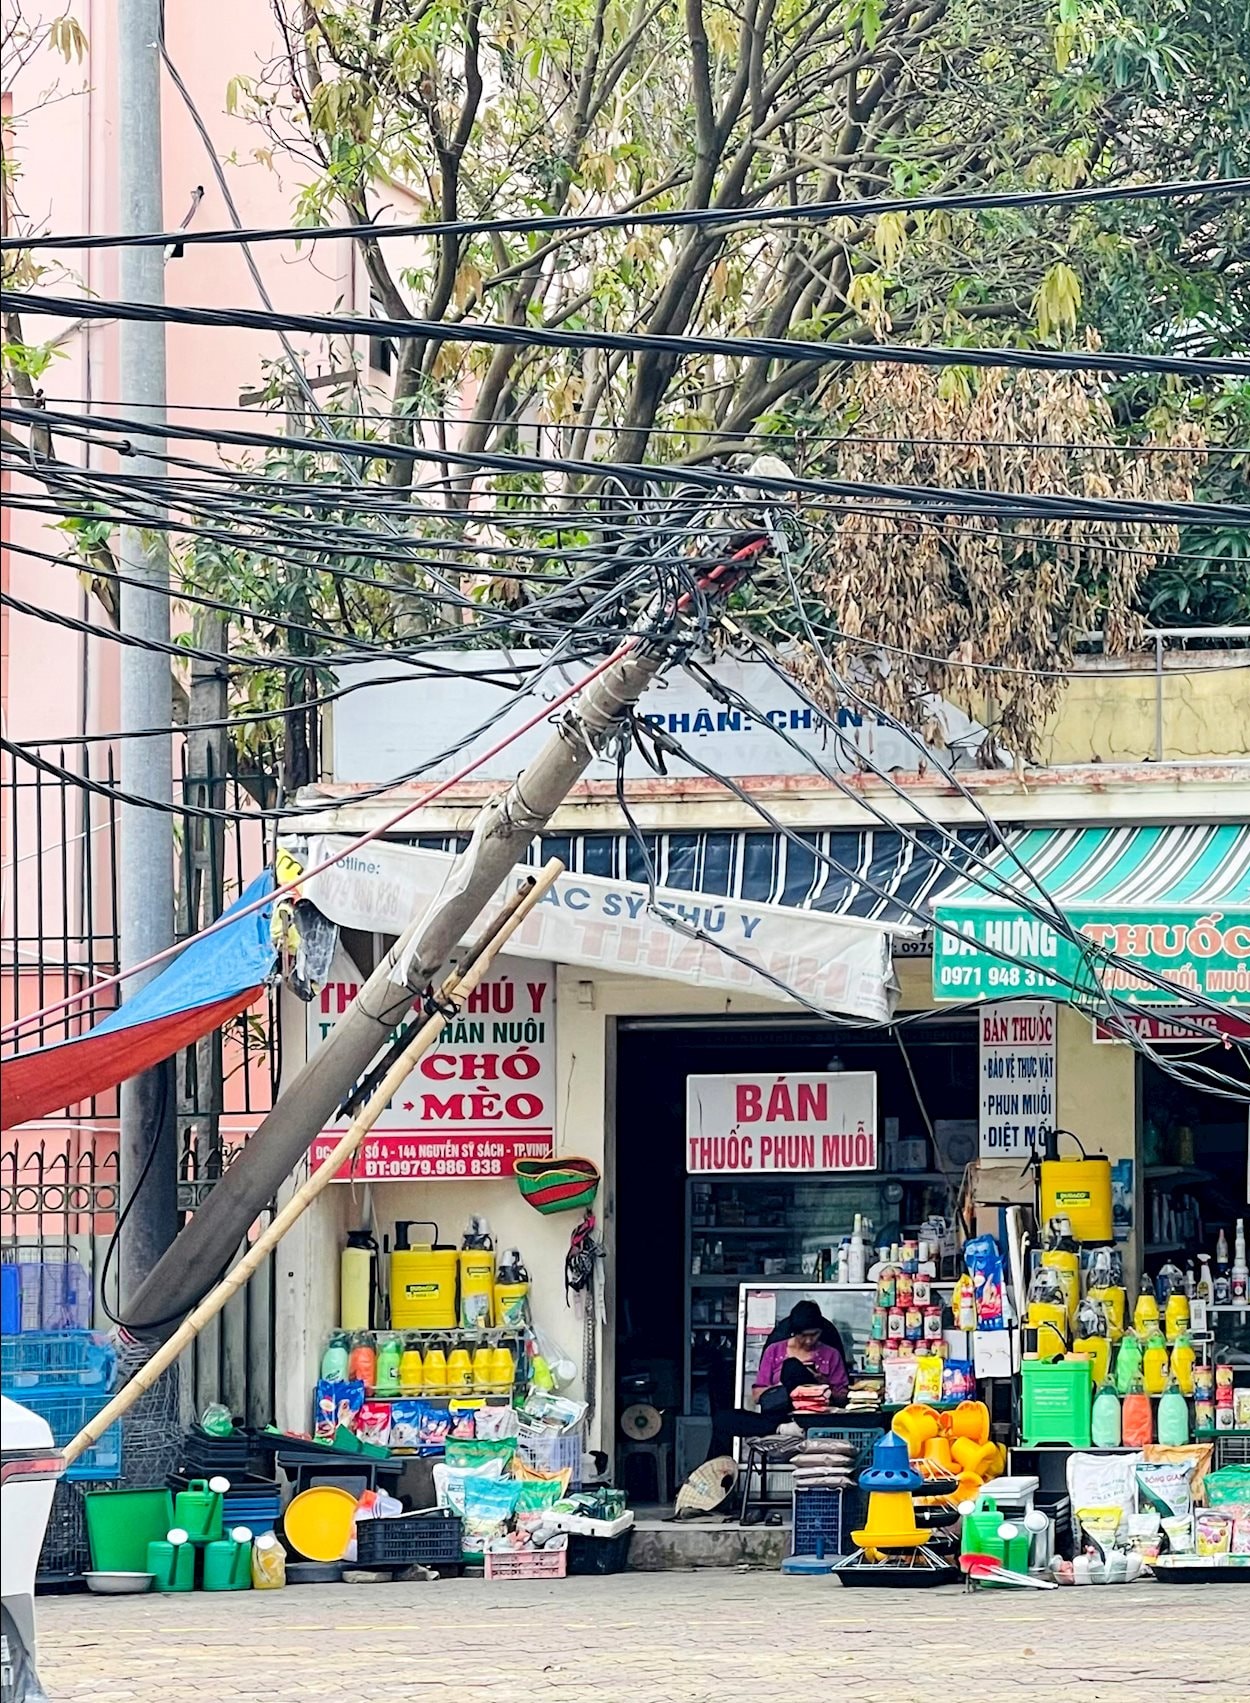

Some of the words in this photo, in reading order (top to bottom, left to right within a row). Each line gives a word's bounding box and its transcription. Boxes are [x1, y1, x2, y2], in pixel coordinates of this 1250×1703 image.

[769, 706, 863, 730] CHN
[740, 914, 762, 939] Y
[941, 966, 981, 986] 0971
[988, 966, 1020, 986] 948
[466, 975, 514, 1014] HÚ
[527, 982, 547, 1014] Y
[437, 1017, 484, 1044] HĂN
[493, 1017, 545, 1044] NUÔI
[984, 1010, 1008, 1042] BÁN
[1012, 1005, 1053, 1042] THUỐC
[420, 1046, 541, 1080] CHÓ
[420, 1086, 544, 1120] MÈO
[735, 1077, 828, 1123] BÁN
[988, 1094, 1019, 1116] PHUN
[1022, 1086, 1051, 1115] MUỖI
[477, 1140, 504, 1158] SÁCH
[689, 1125, 753, 1170] THUỐC
[761, 1134, 815, 1169] PHUN
[822, 1121, 875, 1168] MUỖI
[988, 1122, 1020, 1152] DIỆT
[471, 1159, 501, 1174] 838
